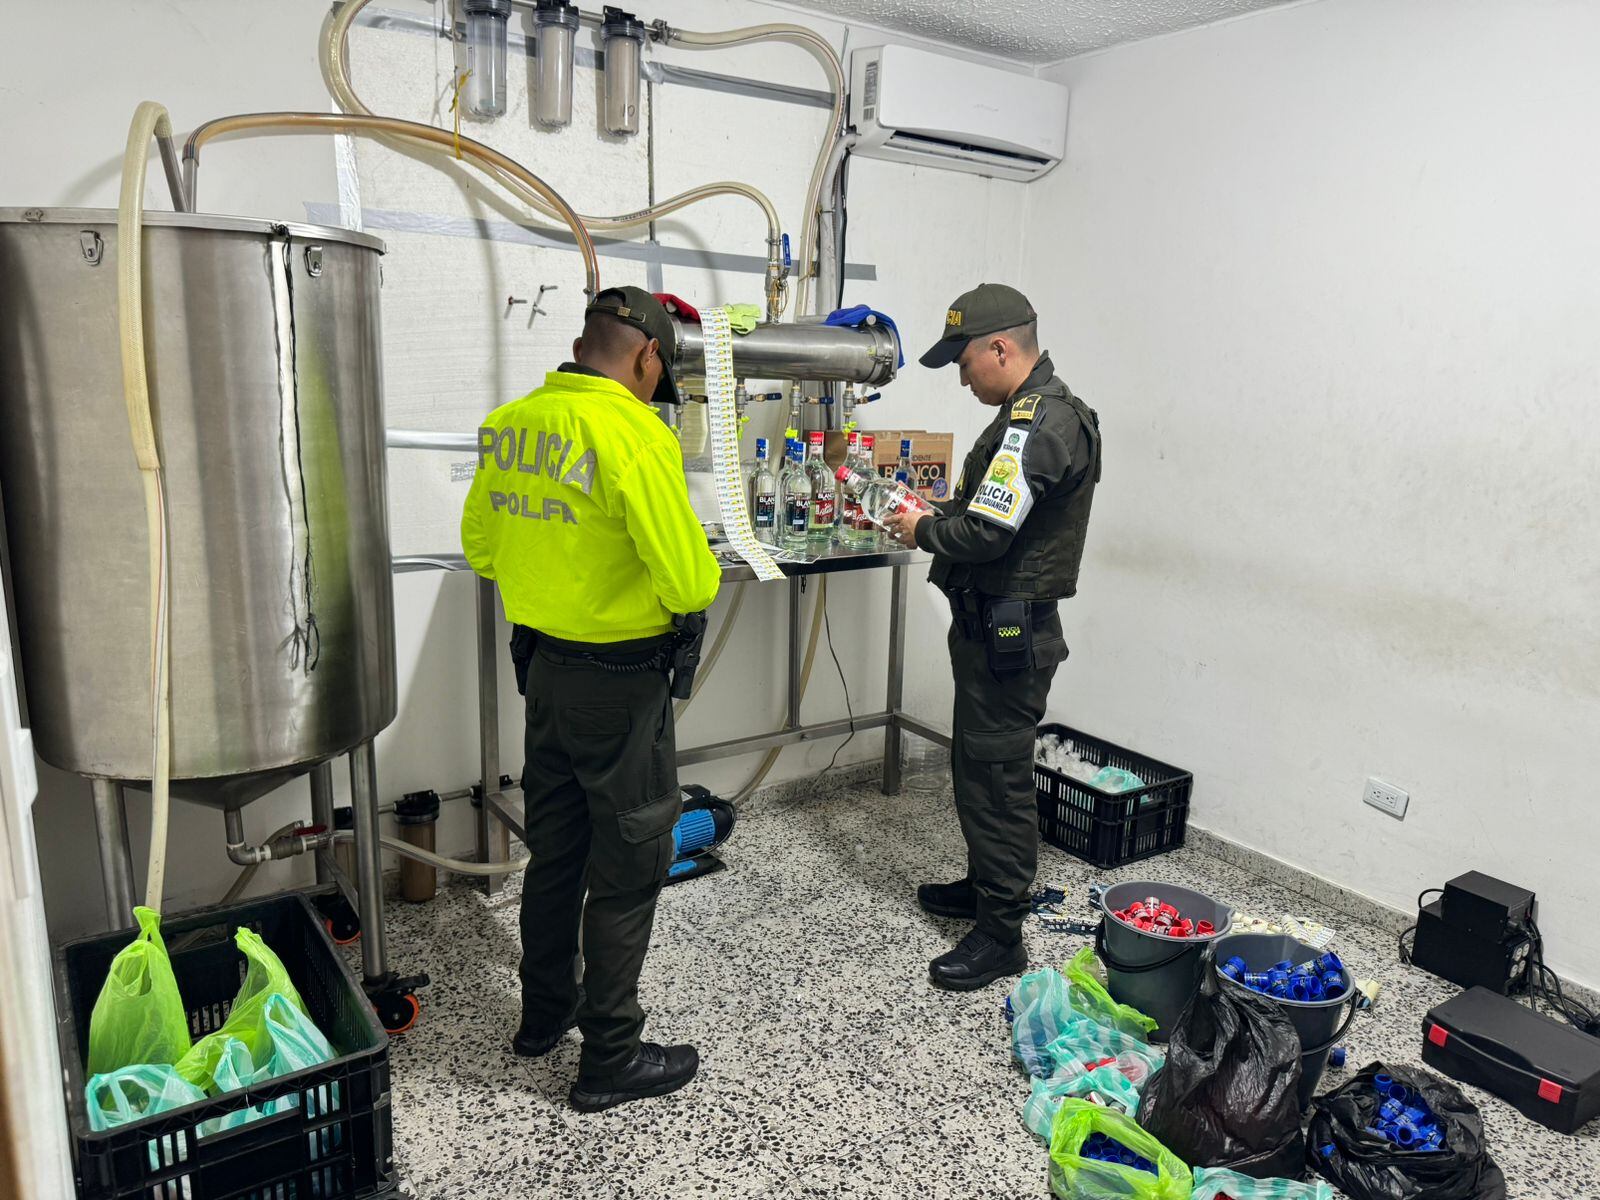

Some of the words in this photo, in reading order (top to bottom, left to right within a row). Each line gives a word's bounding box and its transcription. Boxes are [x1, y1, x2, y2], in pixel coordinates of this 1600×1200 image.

[478, 426, 597, 495] POLICIA
[884, 464, 940, 480] BNCO
[489, 491, 578, 525] POLFA
